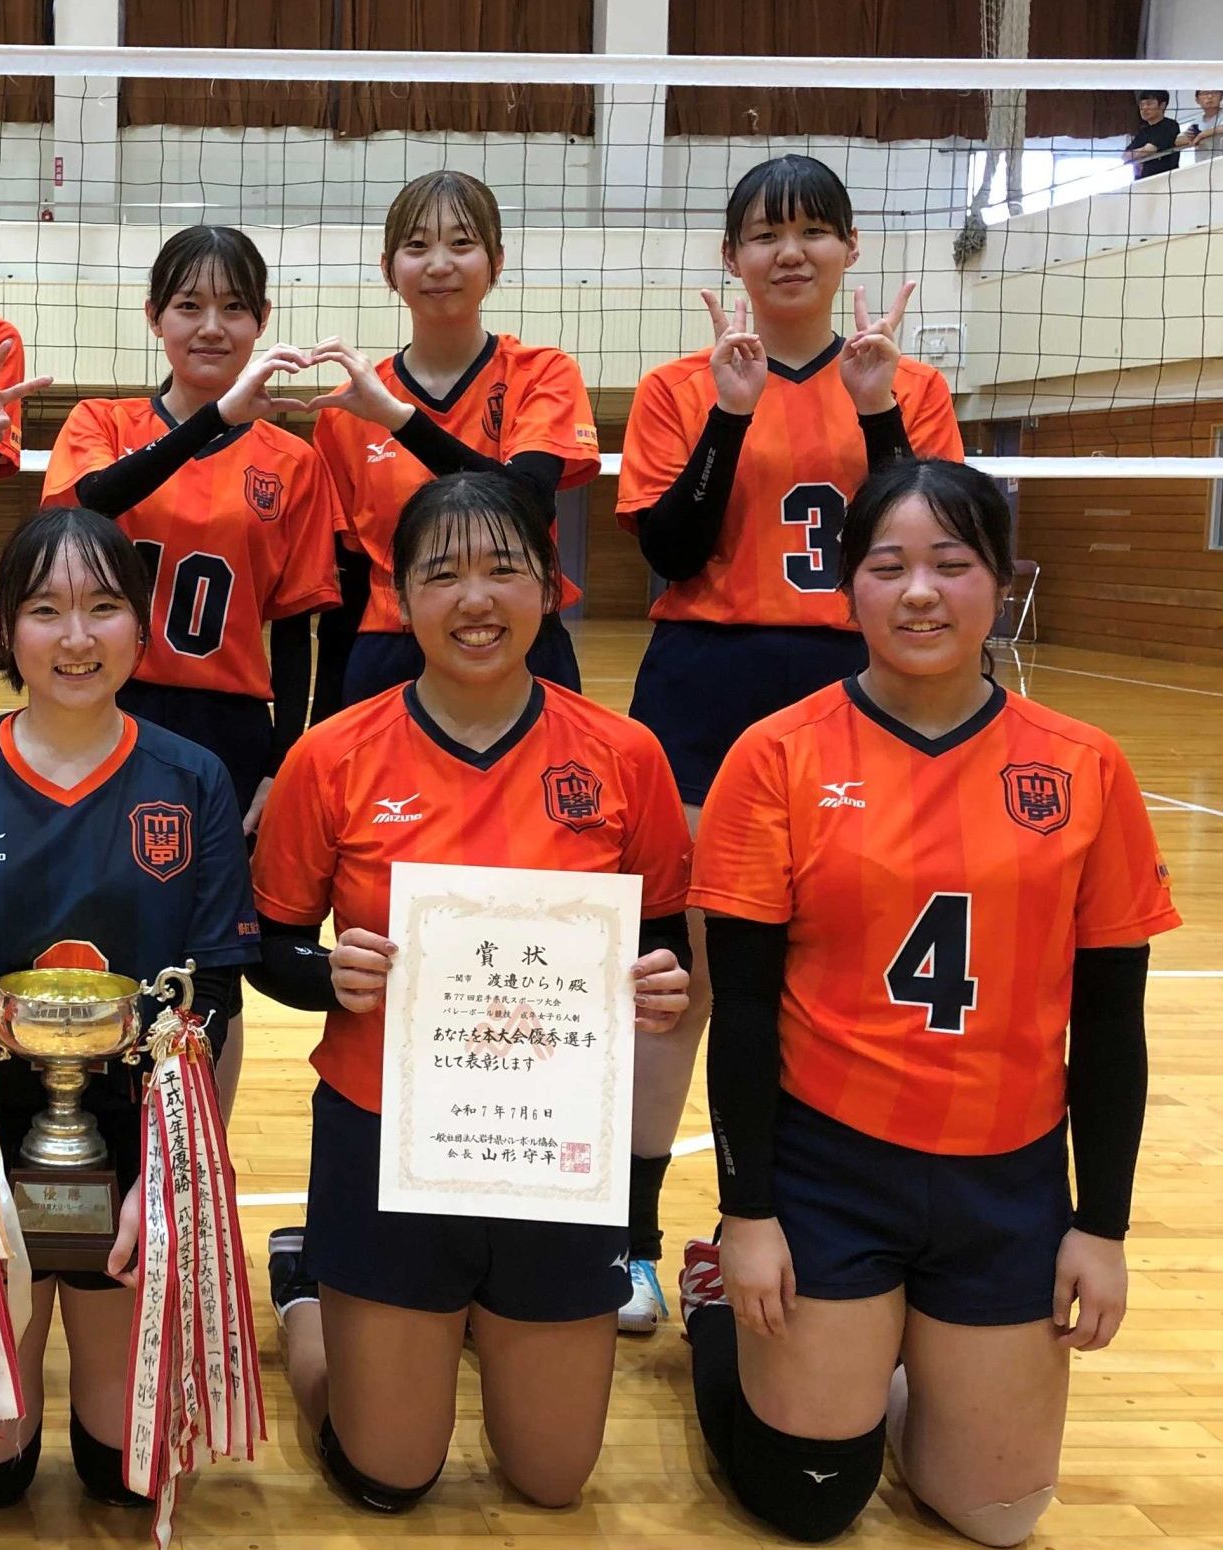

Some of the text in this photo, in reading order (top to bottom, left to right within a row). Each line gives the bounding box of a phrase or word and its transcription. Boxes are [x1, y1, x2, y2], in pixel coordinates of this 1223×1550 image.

[781, 482, 848, 593] 3
[818, 797, 866, 808] MIZUNO
[372, 813, 423, 824] MIZUNO
[475, 940, 549, 967] 賞状
[883, 892, 978, 1035] 4
[446, 974, 472, 983] 一関市
[443, 992, 562, 1007] 第77回岩手県民スポーツ大会
[443, 1007, 512, 1019] バレーボール競技
[433, 1027, 597, 1047] あなたを本大会優秀選手
[433, 1055, 535, 1073] として表彰します
[450, 1104, 553, 1121] 令和7年7月6日
[161, 1070, 192, 1194] 平成七年度優勝
[430, 1132, 559, 1148] 一般社団法人岩手県バレーボール協会
[447, 1148, 474, 1160] 会長
[481, 1148, 557, 1165] 山形守平
